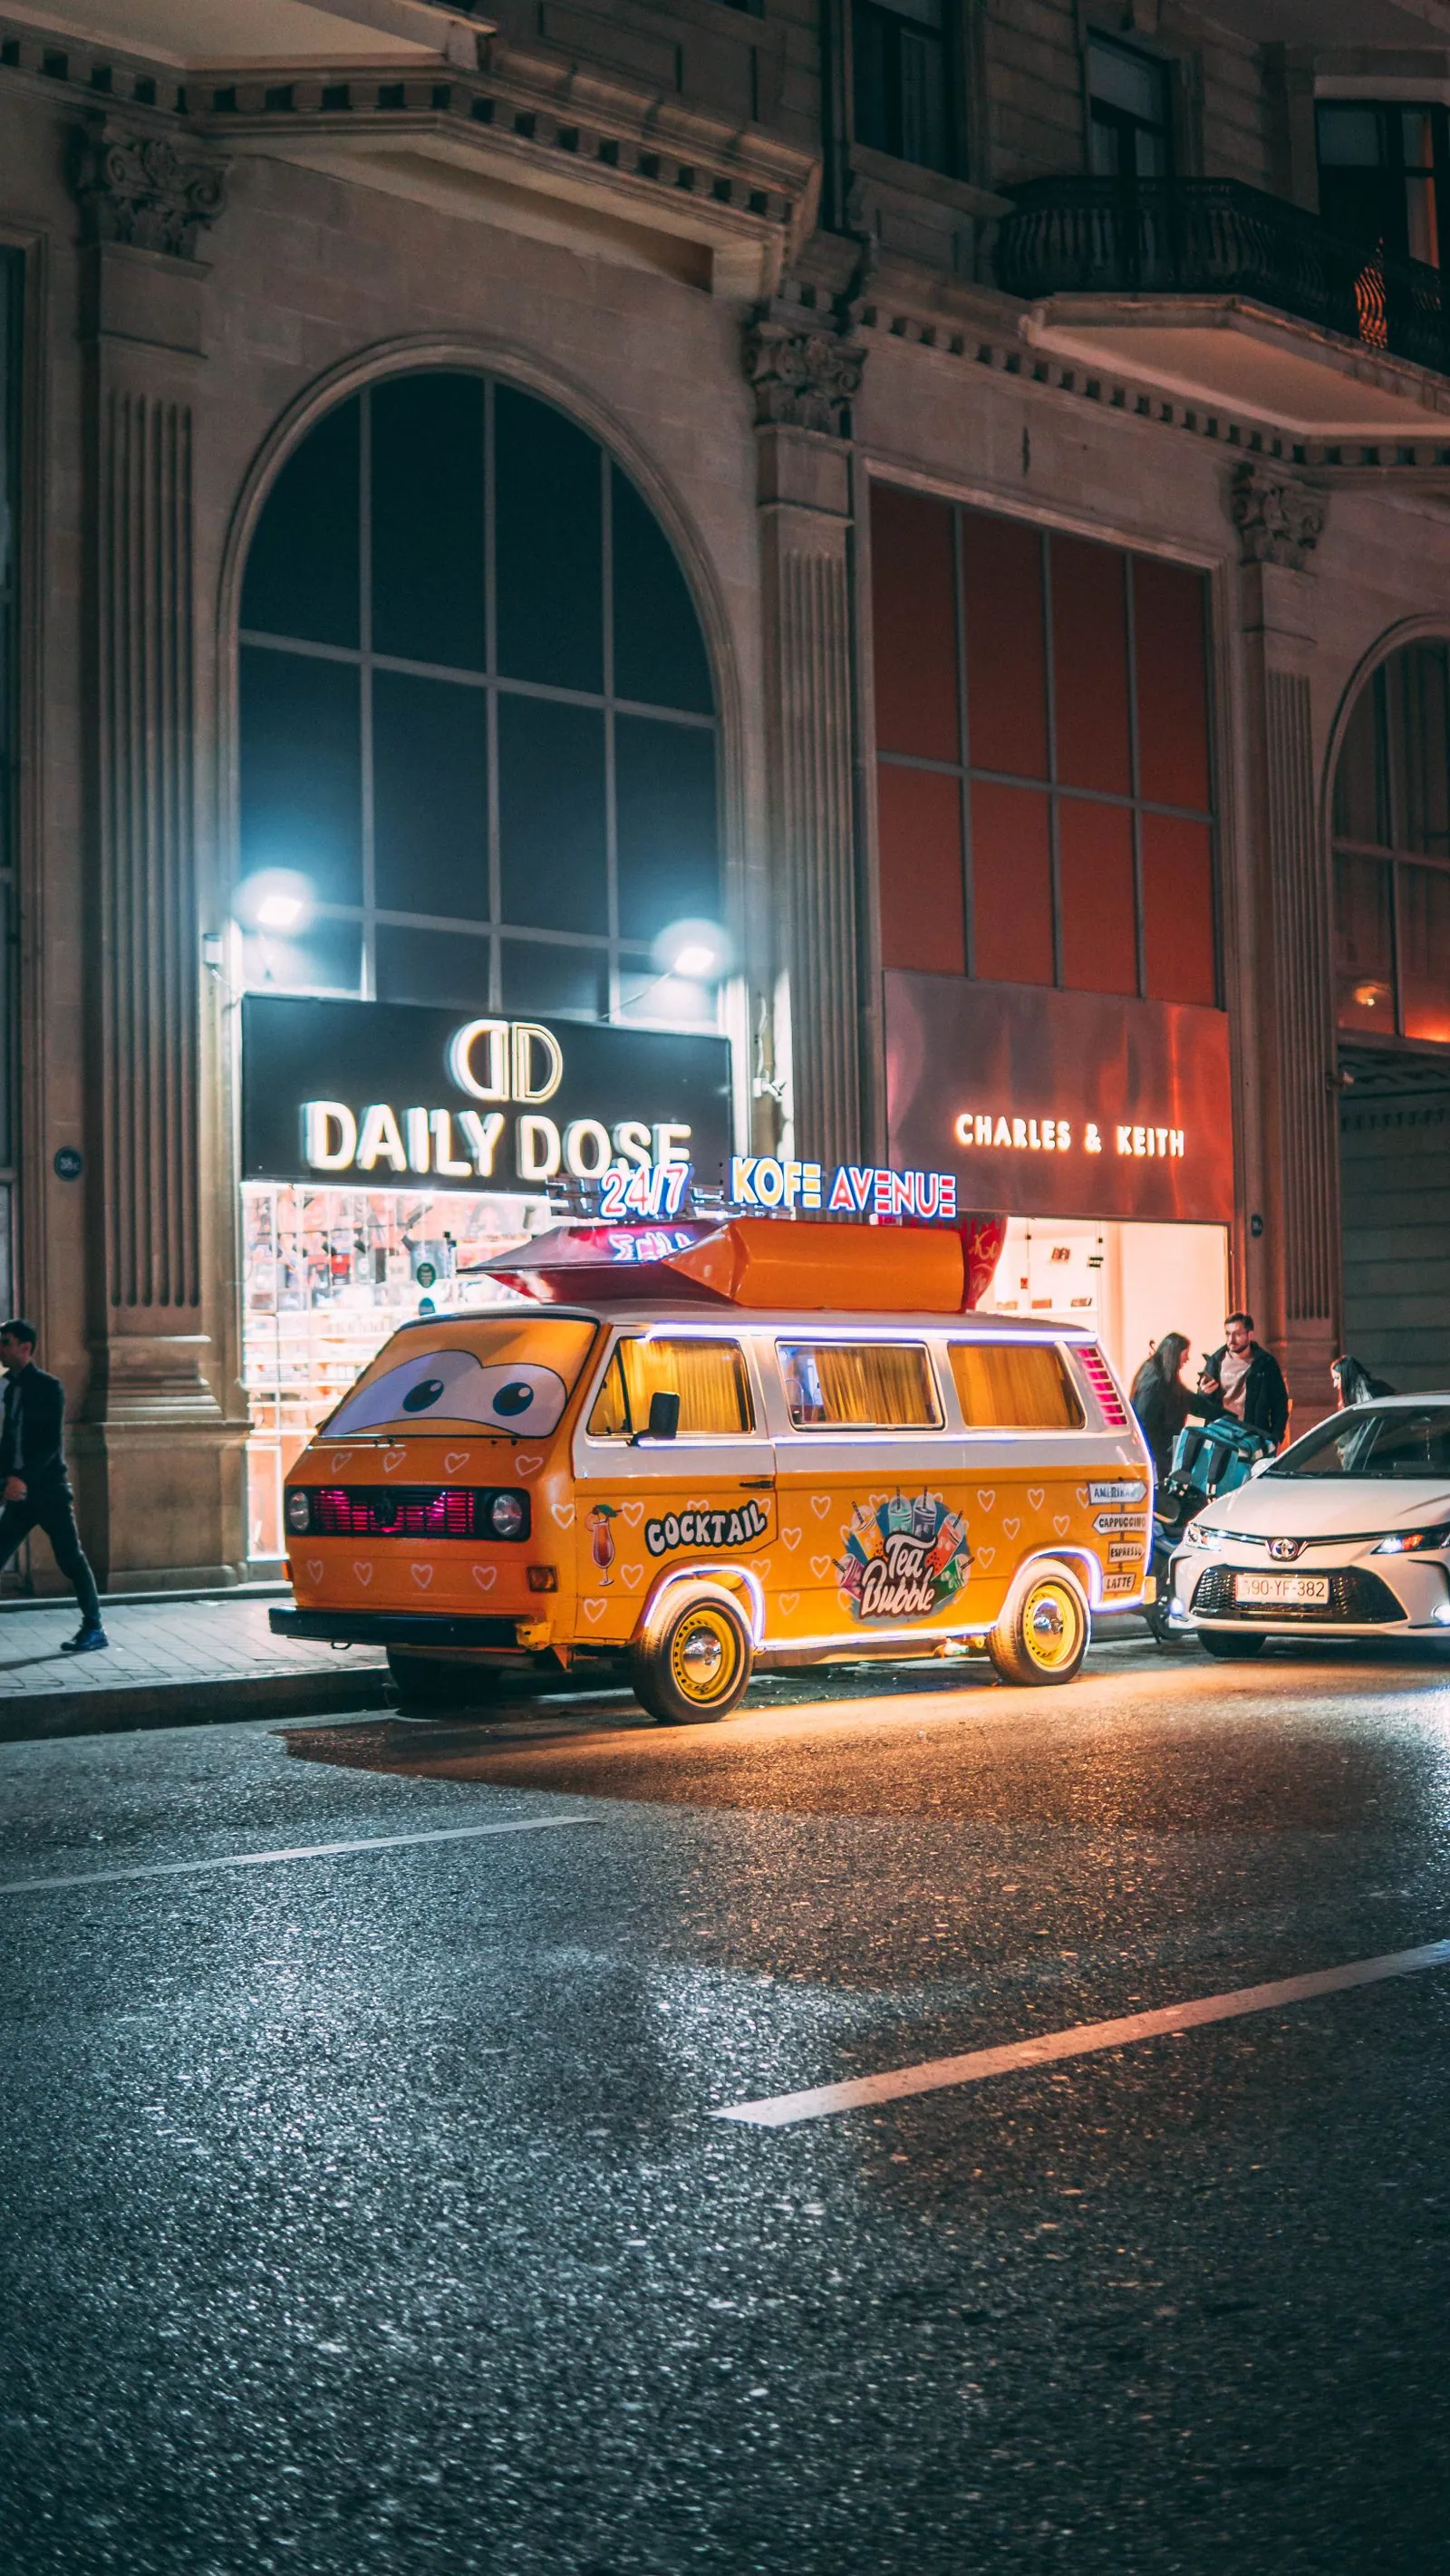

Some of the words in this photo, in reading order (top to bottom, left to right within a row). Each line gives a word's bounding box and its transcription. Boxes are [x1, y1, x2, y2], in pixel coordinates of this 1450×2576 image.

[303, 1100, 504, 1177] DAILY
[516, 1114, 692, 1181] DOSE
[955, 1114, 1071, 1152] CHARLES
[1085, 1124, 1102, 1153] &
[1117, 1125, 1185, 1157] KEITH
[600, 1162, 691, 1218] 24/7
[731, 1157, 822, 1209] KOFE
[828, 1166, 958, 1218] AVENUE
[647, 1501, 768, 1554] COCKTAIL
[1110, 1547, 1143, 1558] ESPRESSO
[884, 1532, 938, 1579] Tea
[861, 1559, 936, 1617] Bubble
[1107, 1577, 1132, 1589] LATTE
